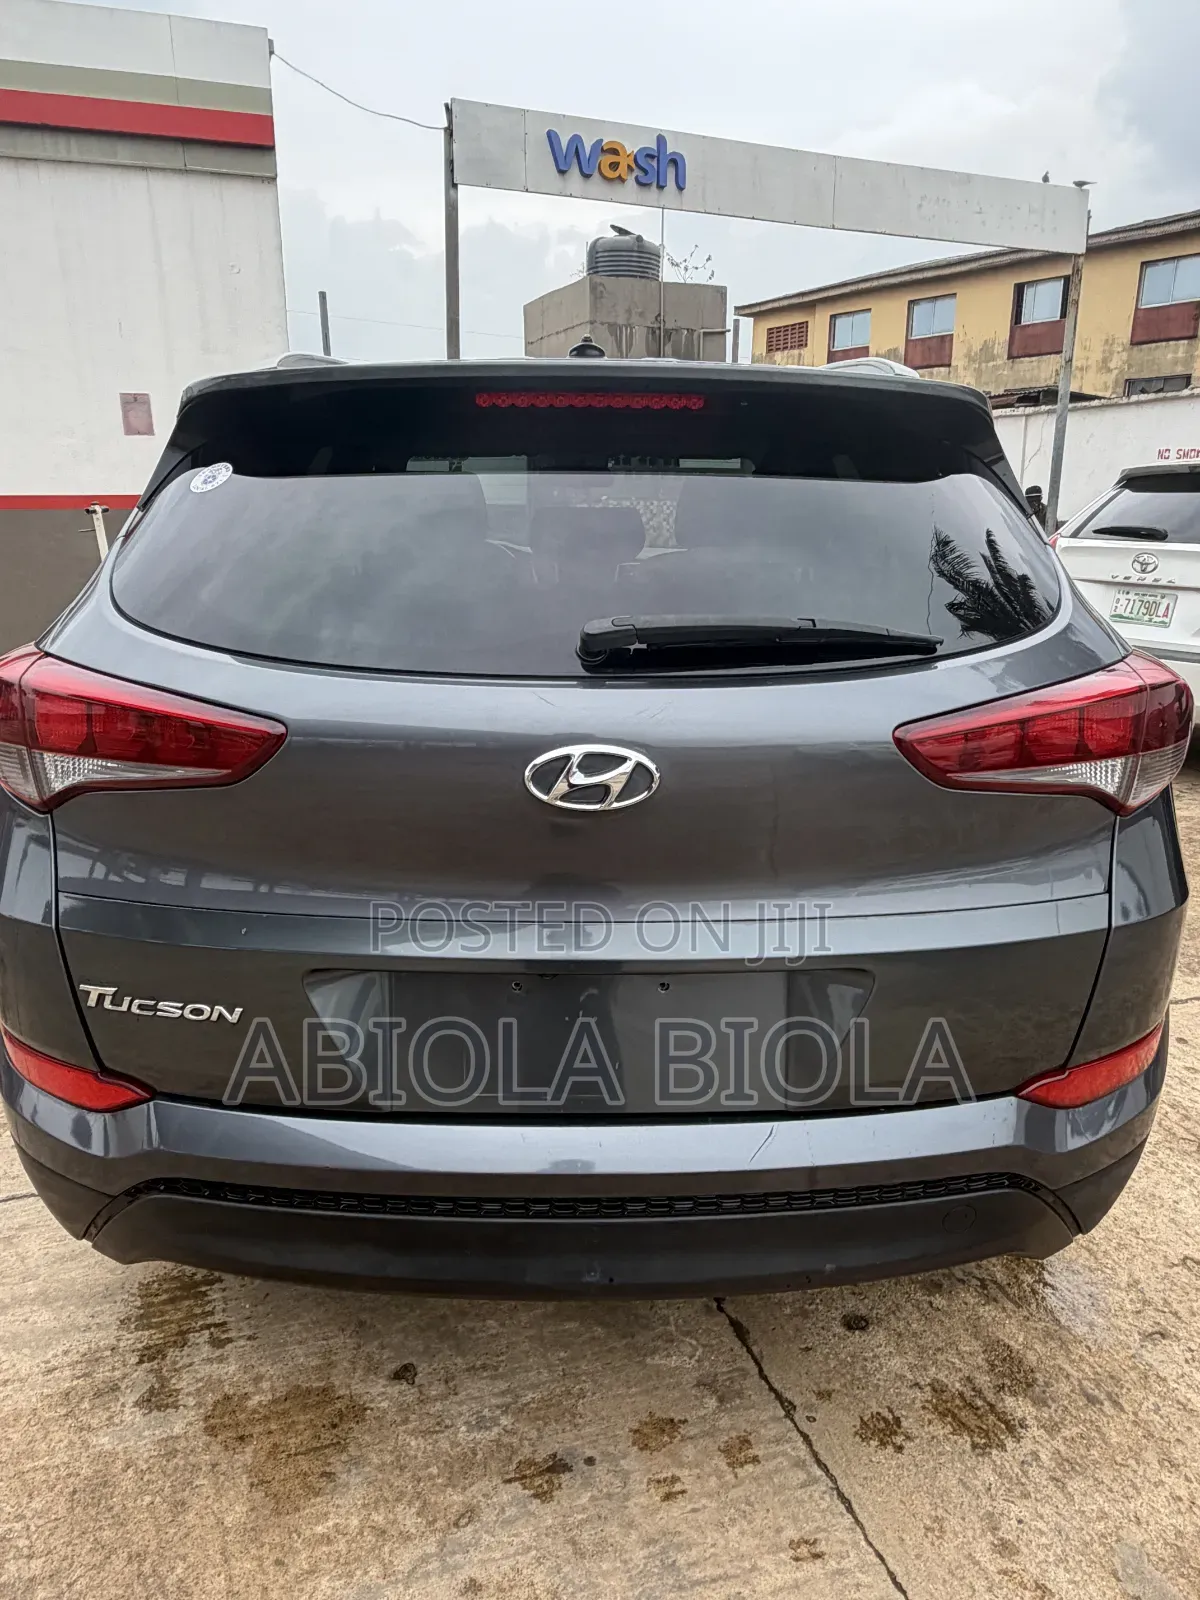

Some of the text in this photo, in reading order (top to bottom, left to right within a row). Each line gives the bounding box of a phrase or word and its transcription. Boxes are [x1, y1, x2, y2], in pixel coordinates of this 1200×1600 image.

[546, 129, 687, 191] wash
[1157, 448, 1171, 460] NO
[79, 984, 244, 1024] TUCSON
